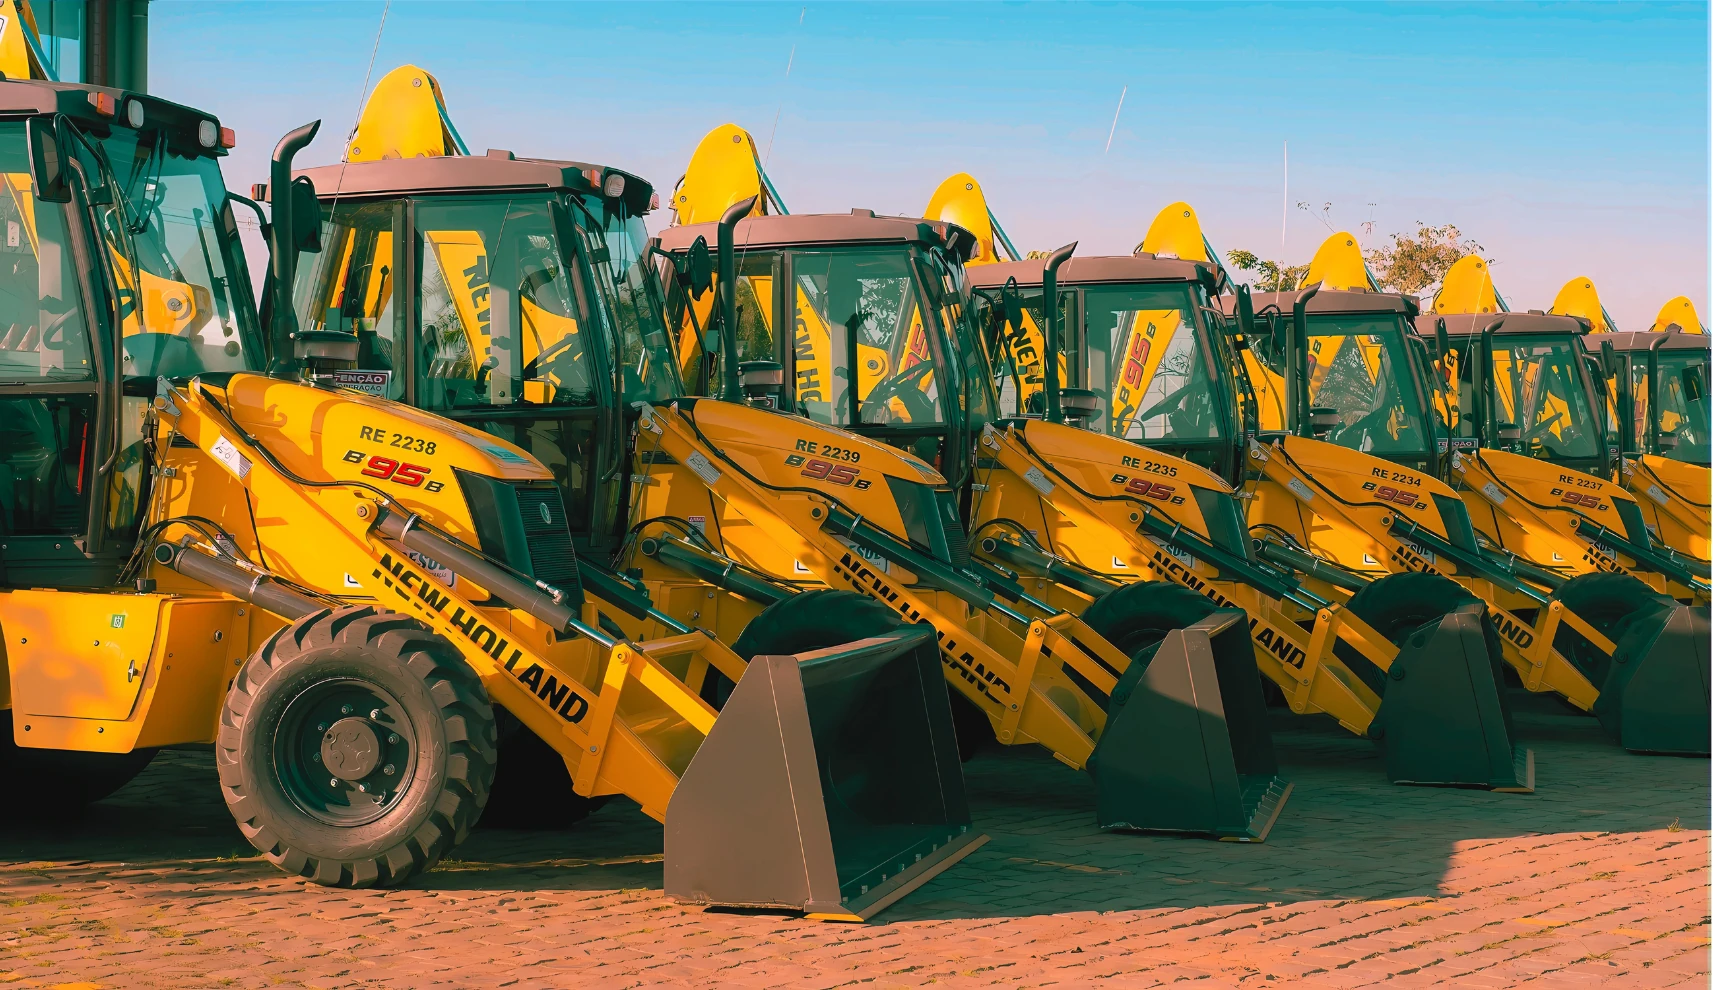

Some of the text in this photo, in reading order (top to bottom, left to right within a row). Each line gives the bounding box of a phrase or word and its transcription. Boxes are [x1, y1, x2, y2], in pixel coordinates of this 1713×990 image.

[360, 425, 437, 455] RE 2238
[796, 439, 860, 463] RE 2239
[1121, 455, 1178, 477] RE 2235
[1372, 467, 1421, 487] RE 2234
[1559, 474, 1603, 491] RE 2237
[834, 552, 899, 603] NEW
[1147, 550, 1206, 592] NEW
[372, 553, 589, 724] NEW HOLLAND
